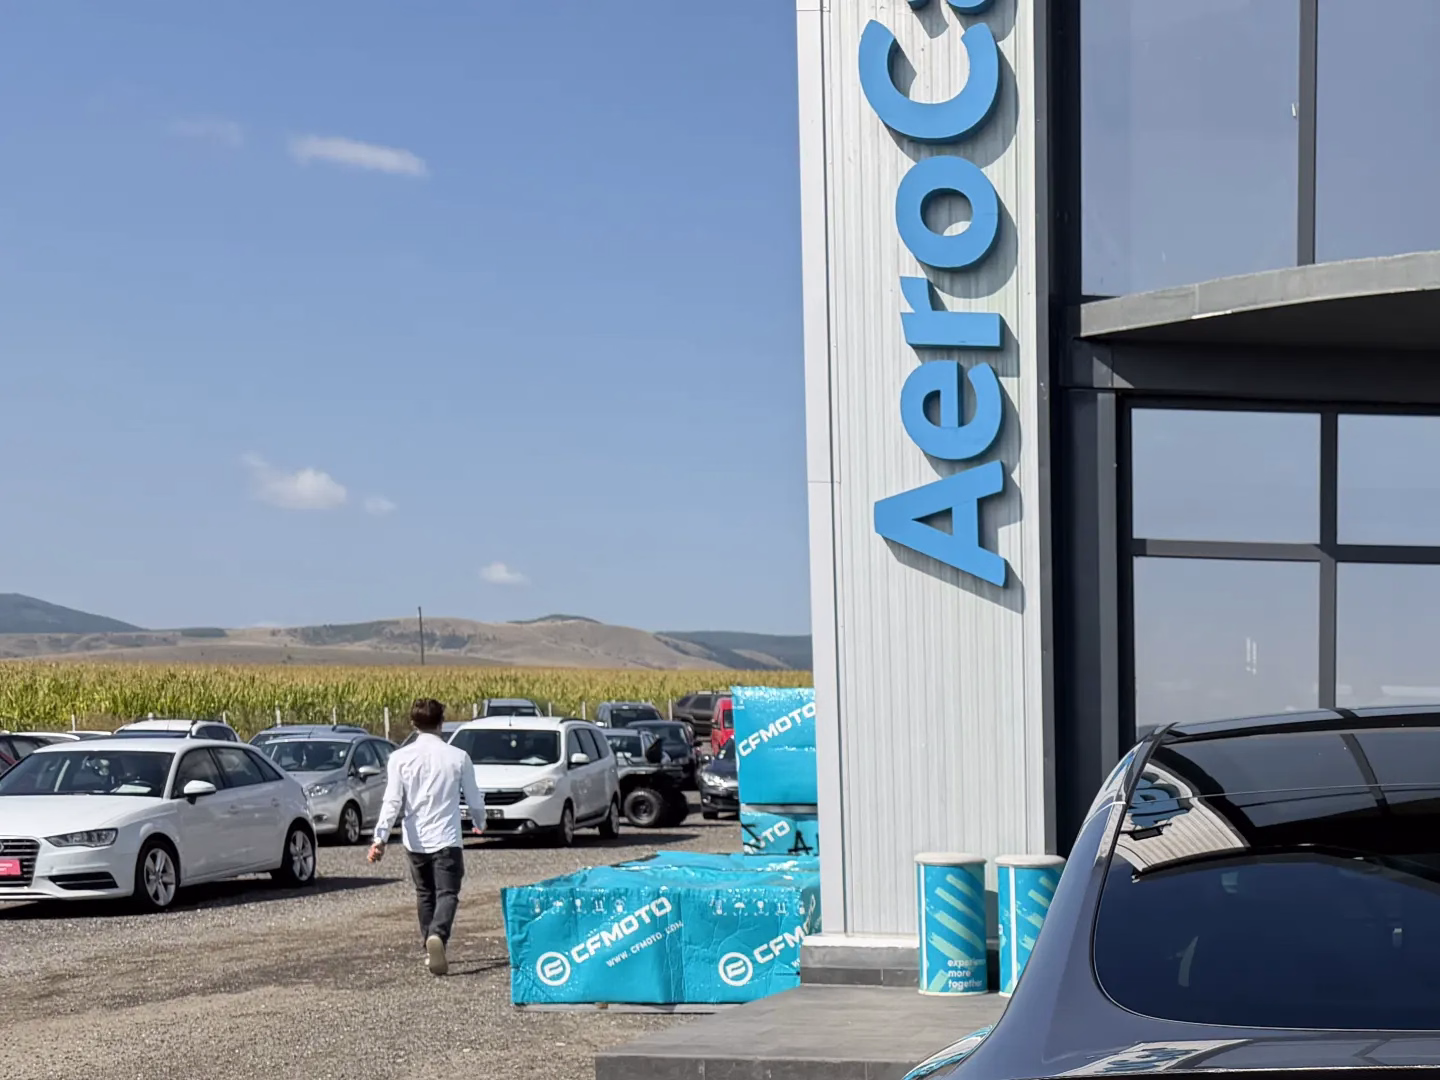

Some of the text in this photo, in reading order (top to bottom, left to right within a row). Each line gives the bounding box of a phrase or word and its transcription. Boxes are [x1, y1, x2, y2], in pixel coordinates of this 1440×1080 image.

[858, 0, 1005, 586] AeroC
[738, 702, 815, 757] CFMOTO
[571, 896, 672, 963] CFMOTO
[947, 969, 971, 977] more
